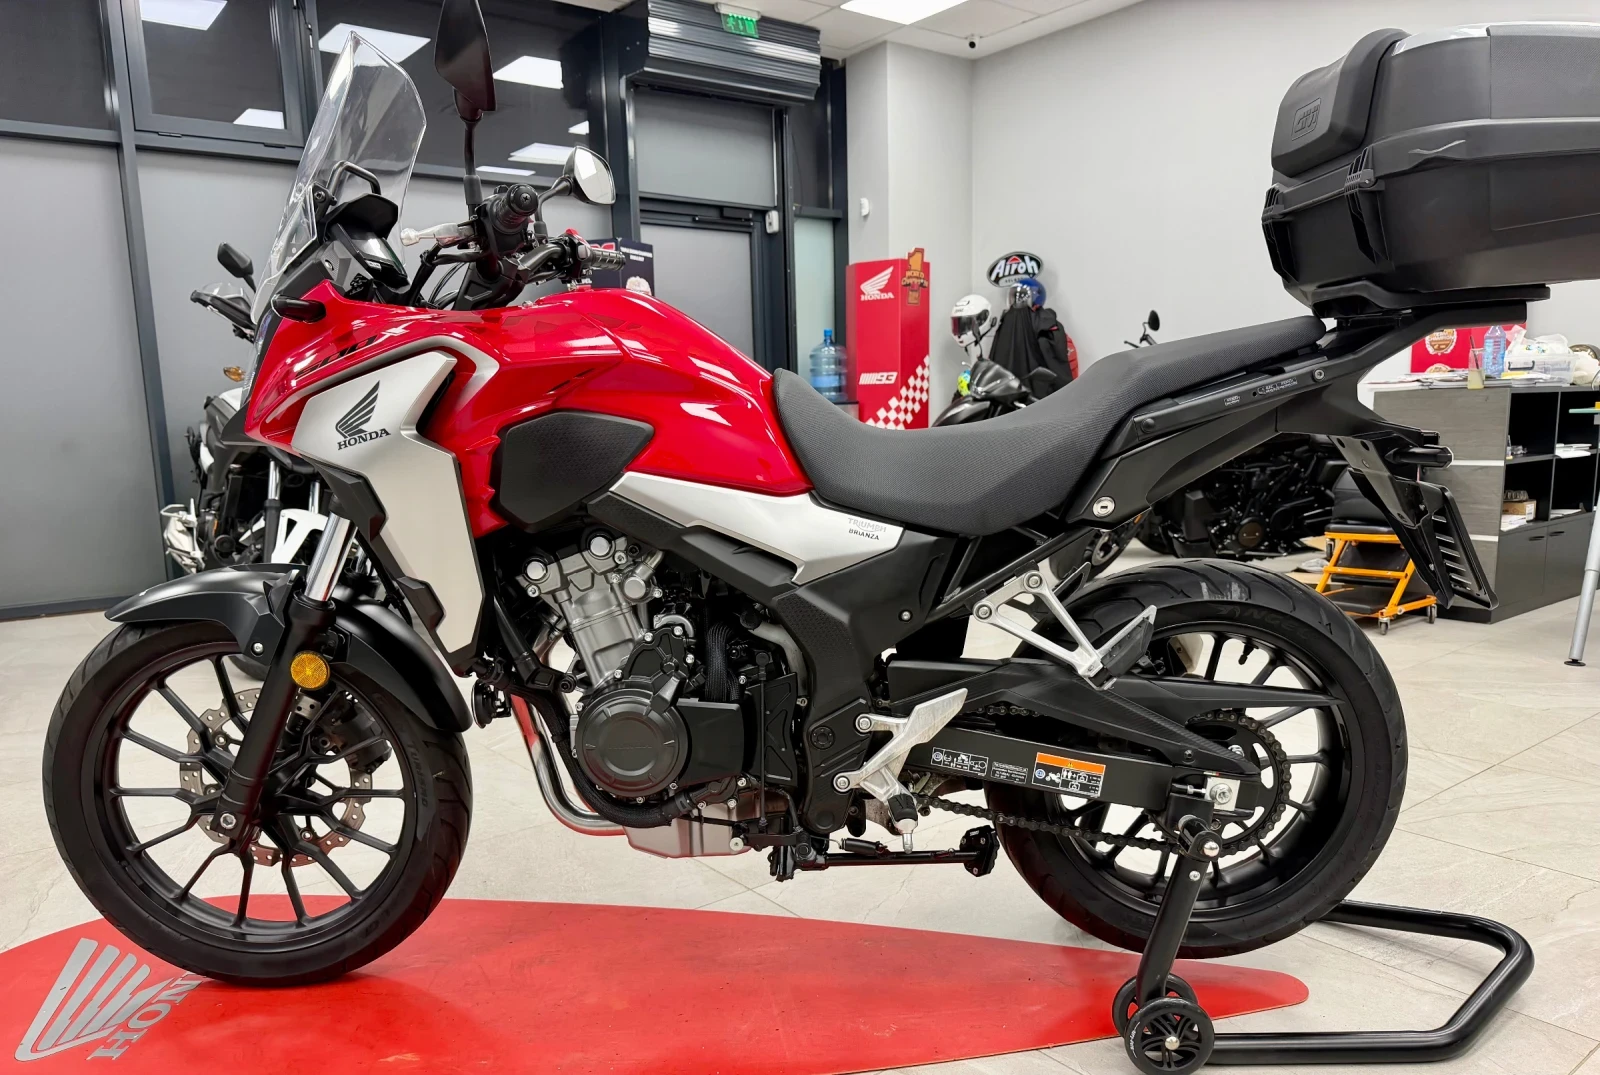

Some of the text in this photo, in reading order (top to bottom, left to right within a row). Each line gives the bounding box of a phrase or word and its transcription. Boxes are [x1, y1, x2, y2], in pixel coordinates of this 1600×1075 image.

[991, 256, 1039, 281] Airoh
[860, 292, 894, 301] HONDA
[337, 428, 391, 450] HONDA
[848, 518, 887, 532] TRIUMPH
[848, 528, 880, 540] BRIANZA
